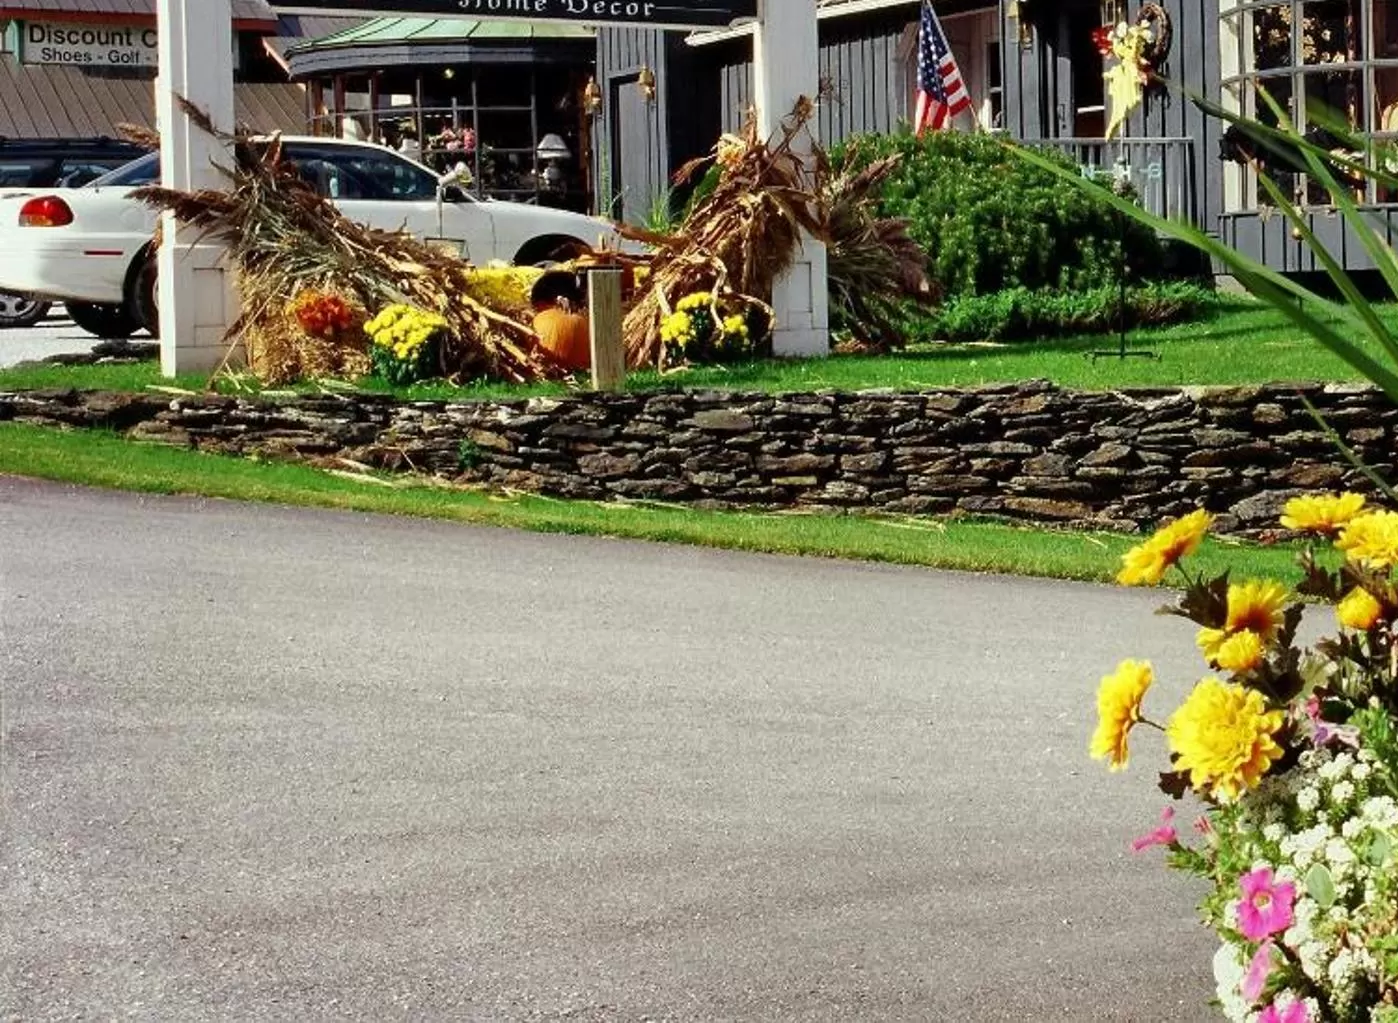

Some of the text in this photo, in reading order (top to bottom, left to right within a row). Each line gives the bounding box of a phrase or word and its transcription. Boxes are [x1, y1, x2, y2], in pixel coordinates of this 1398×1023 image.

[30, 25, 132, 46] Discount
[41, 47, 92, 63] Shoes
[108, 49, 140, 64] Golf
